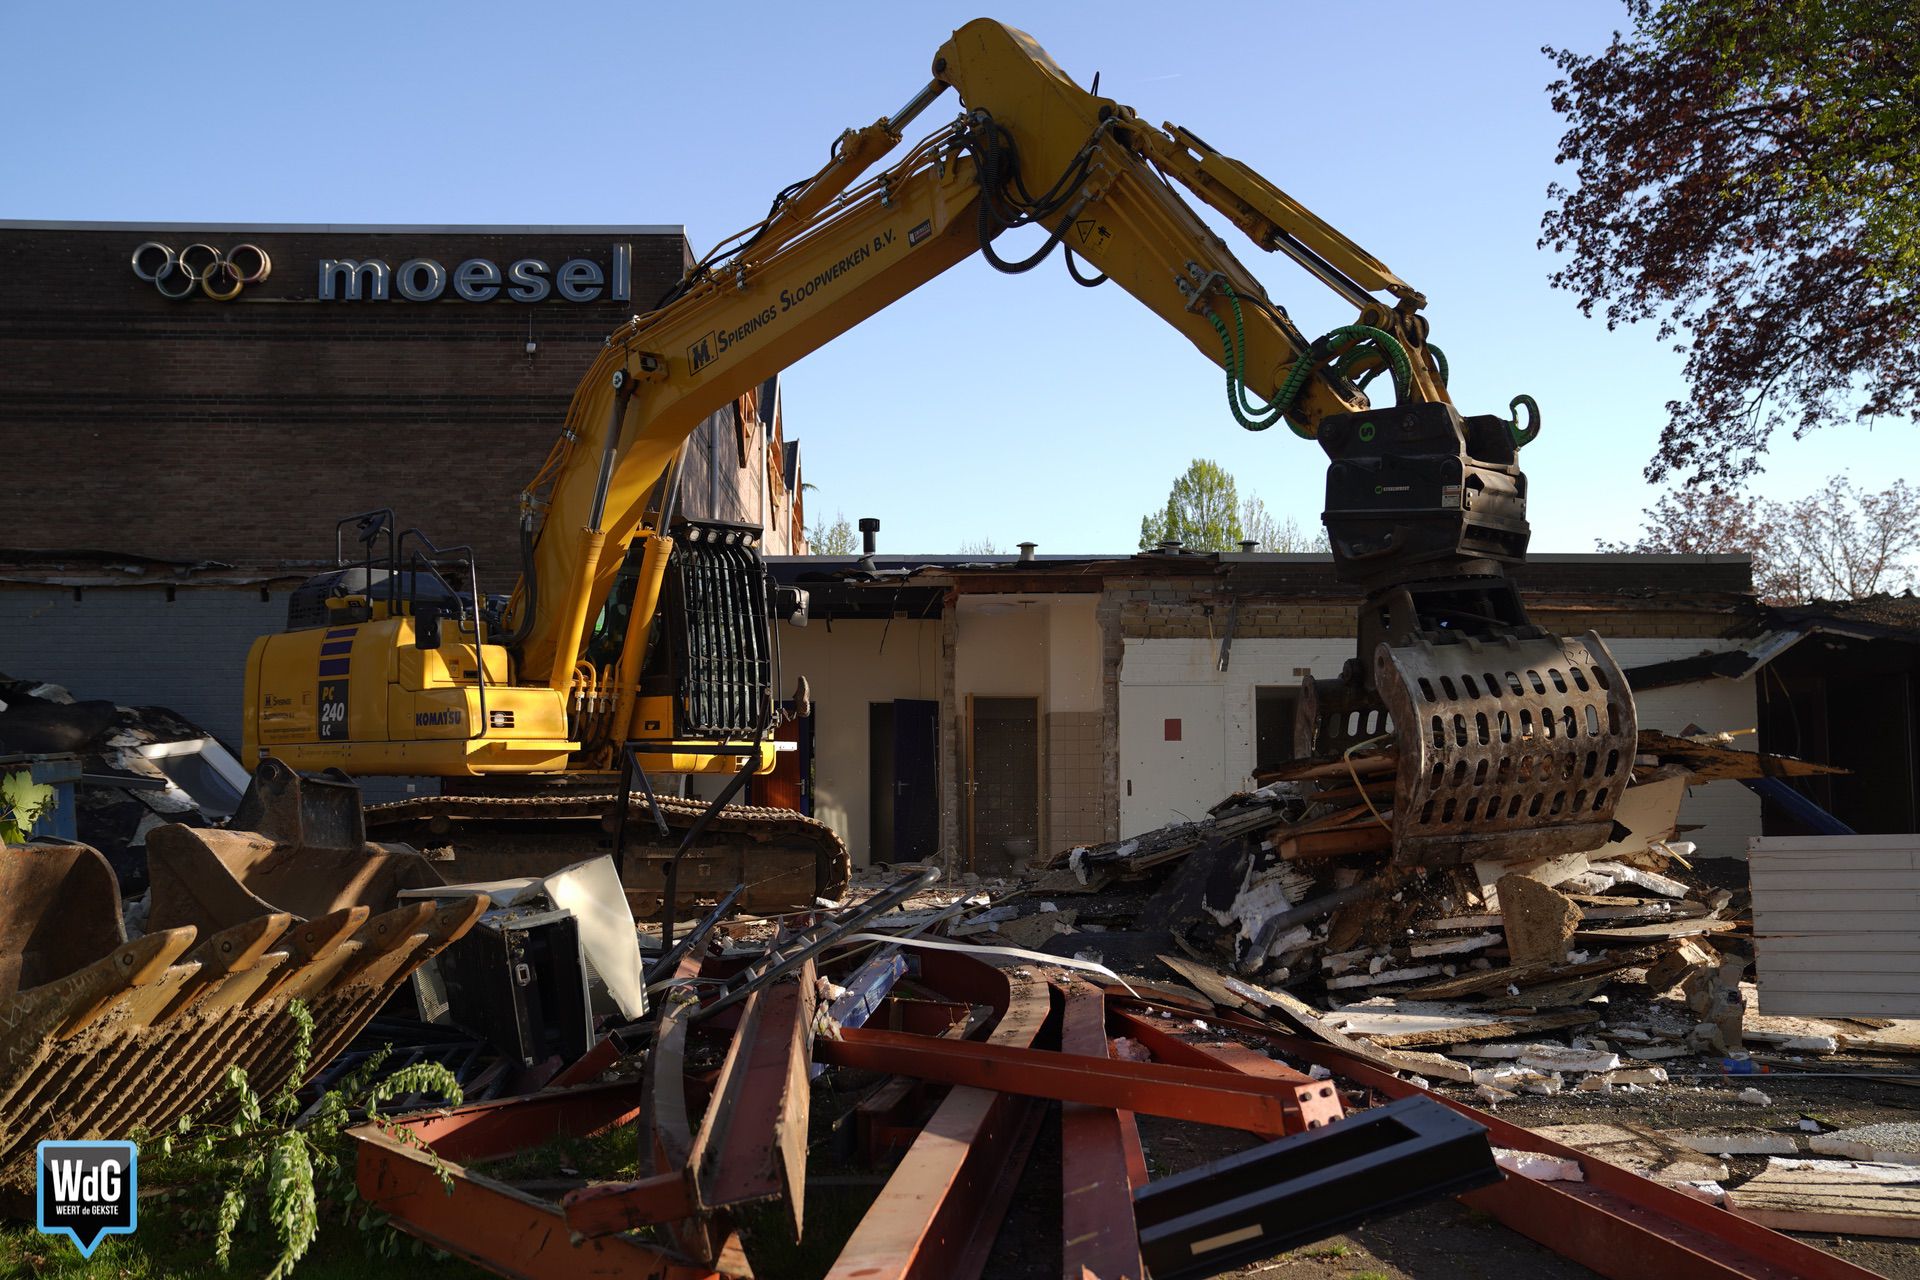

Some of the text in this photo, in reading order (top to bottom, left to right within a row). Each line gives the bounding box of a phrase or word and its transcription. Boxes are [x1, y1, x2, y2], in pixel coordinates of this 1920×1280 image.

[873, 227, 897, 252] B.V.
[318, 243, 631, 302] moesel
[322, 686, 335, 700] PC
[321, 702, 345, 722] 240
[415, 708, 461, 726] KOMATSU
[322, 724, 331, 736] LC
